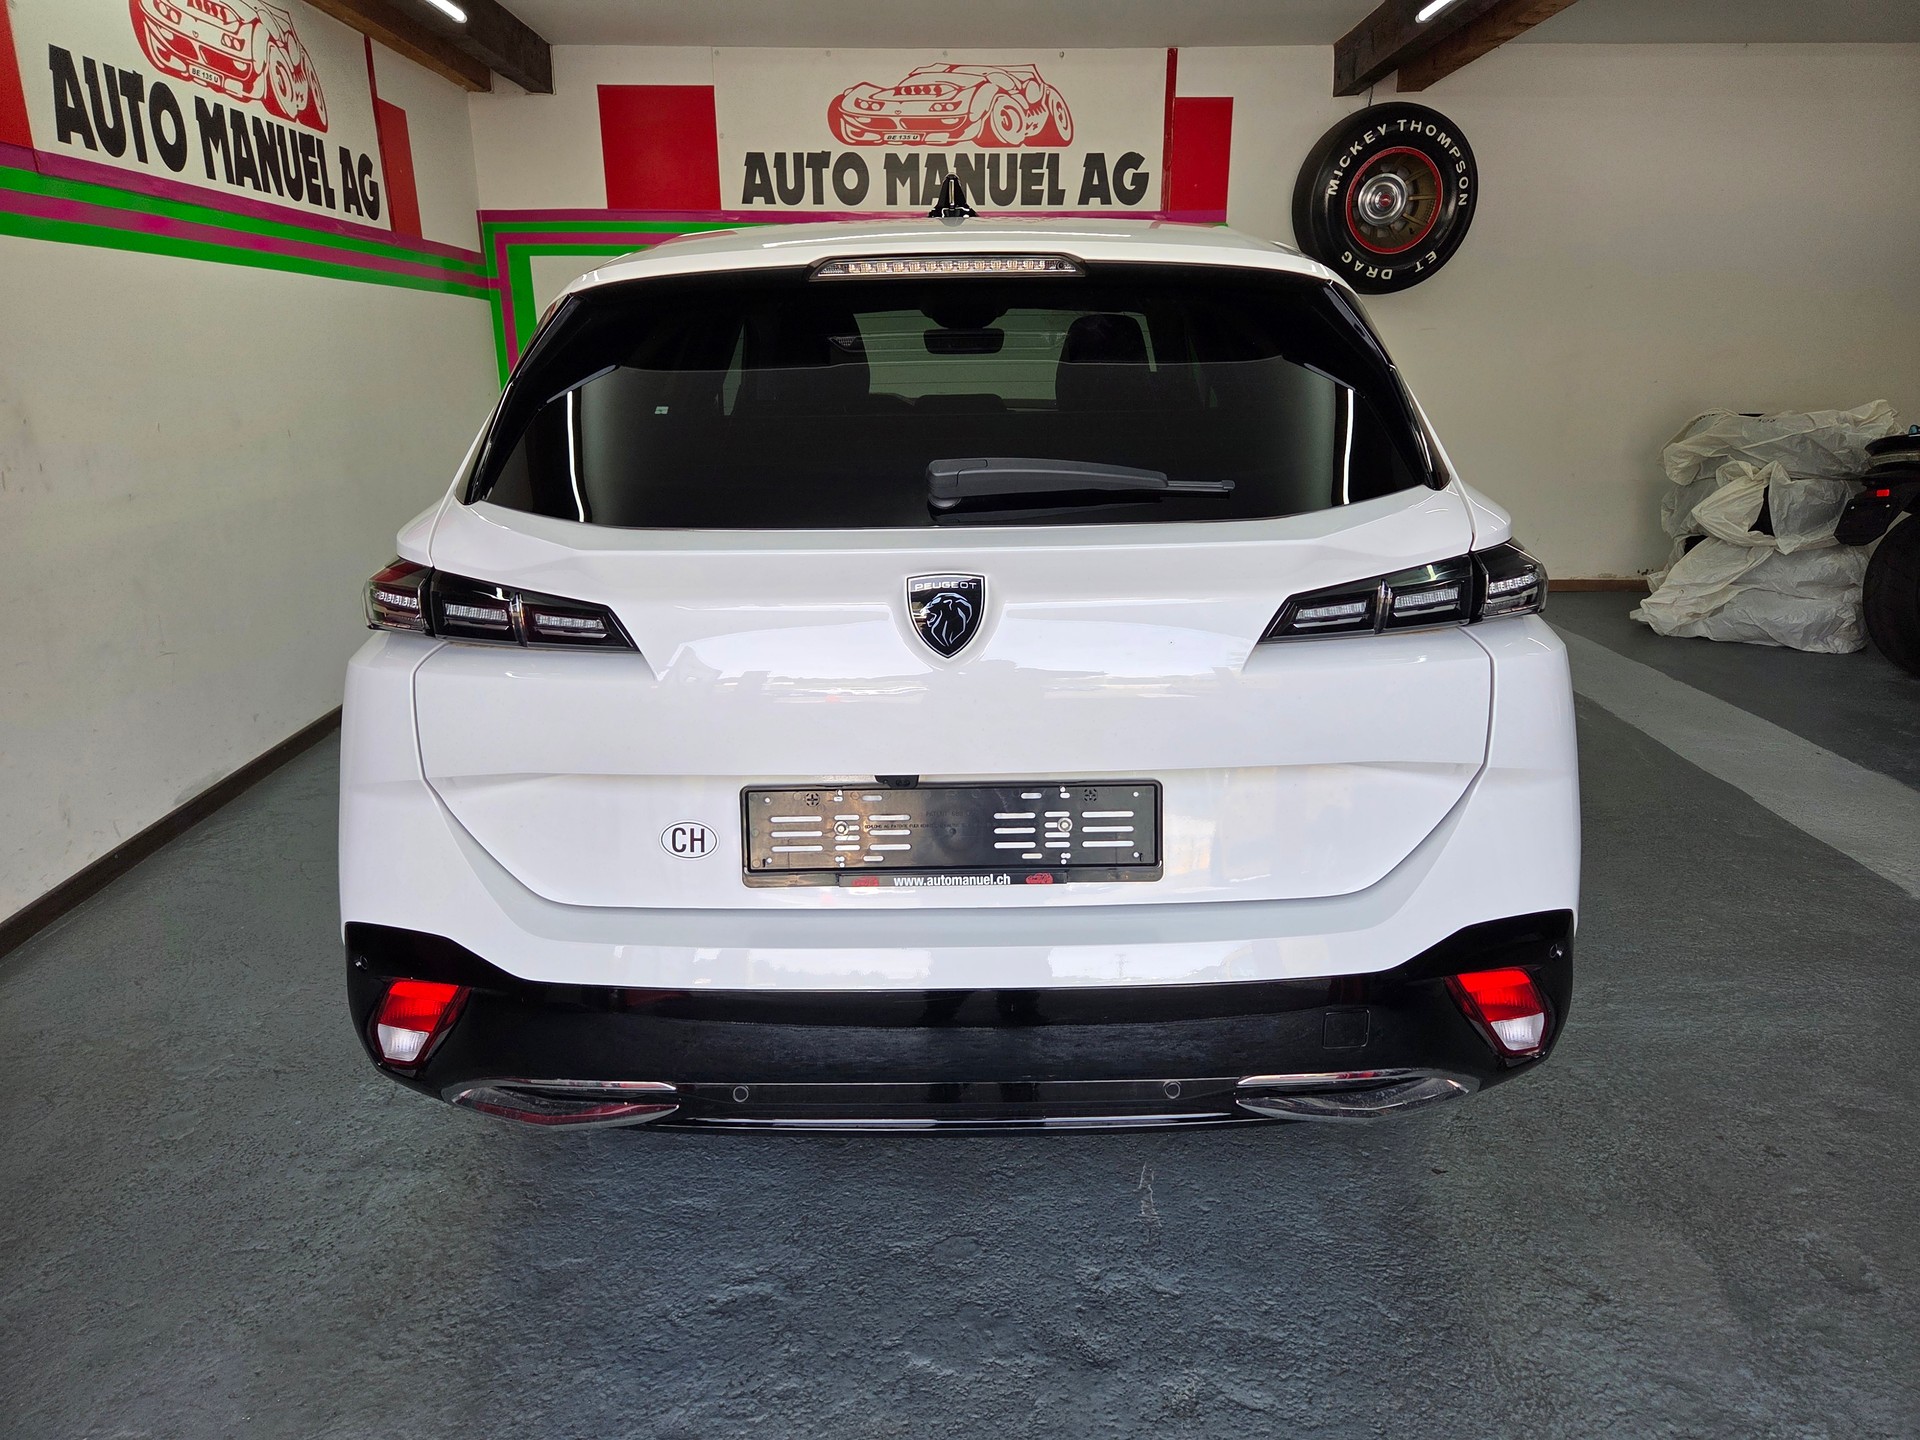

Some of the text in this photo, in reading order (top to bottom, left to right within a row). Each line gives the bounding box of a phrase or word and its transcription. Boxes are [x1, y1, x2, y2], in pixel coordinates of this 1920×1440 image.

[191, 67, 200, 77] BE
[202, 71, 213, 81] 135
[48, 43, 380, 221] AUTO MANUEL AG
[1327, 119, 1470, 206] MICKEY THOMPSON
[741, 150, 1150, 207] AUTO MANUEL AG
[1341, 250, 1438, 281] ET DRAG
[914, 581, 977, 592] PEUGEOT
[671, 827, 706, 853] CH
[893, 873, 1011, 887] www.automanuel.ch
